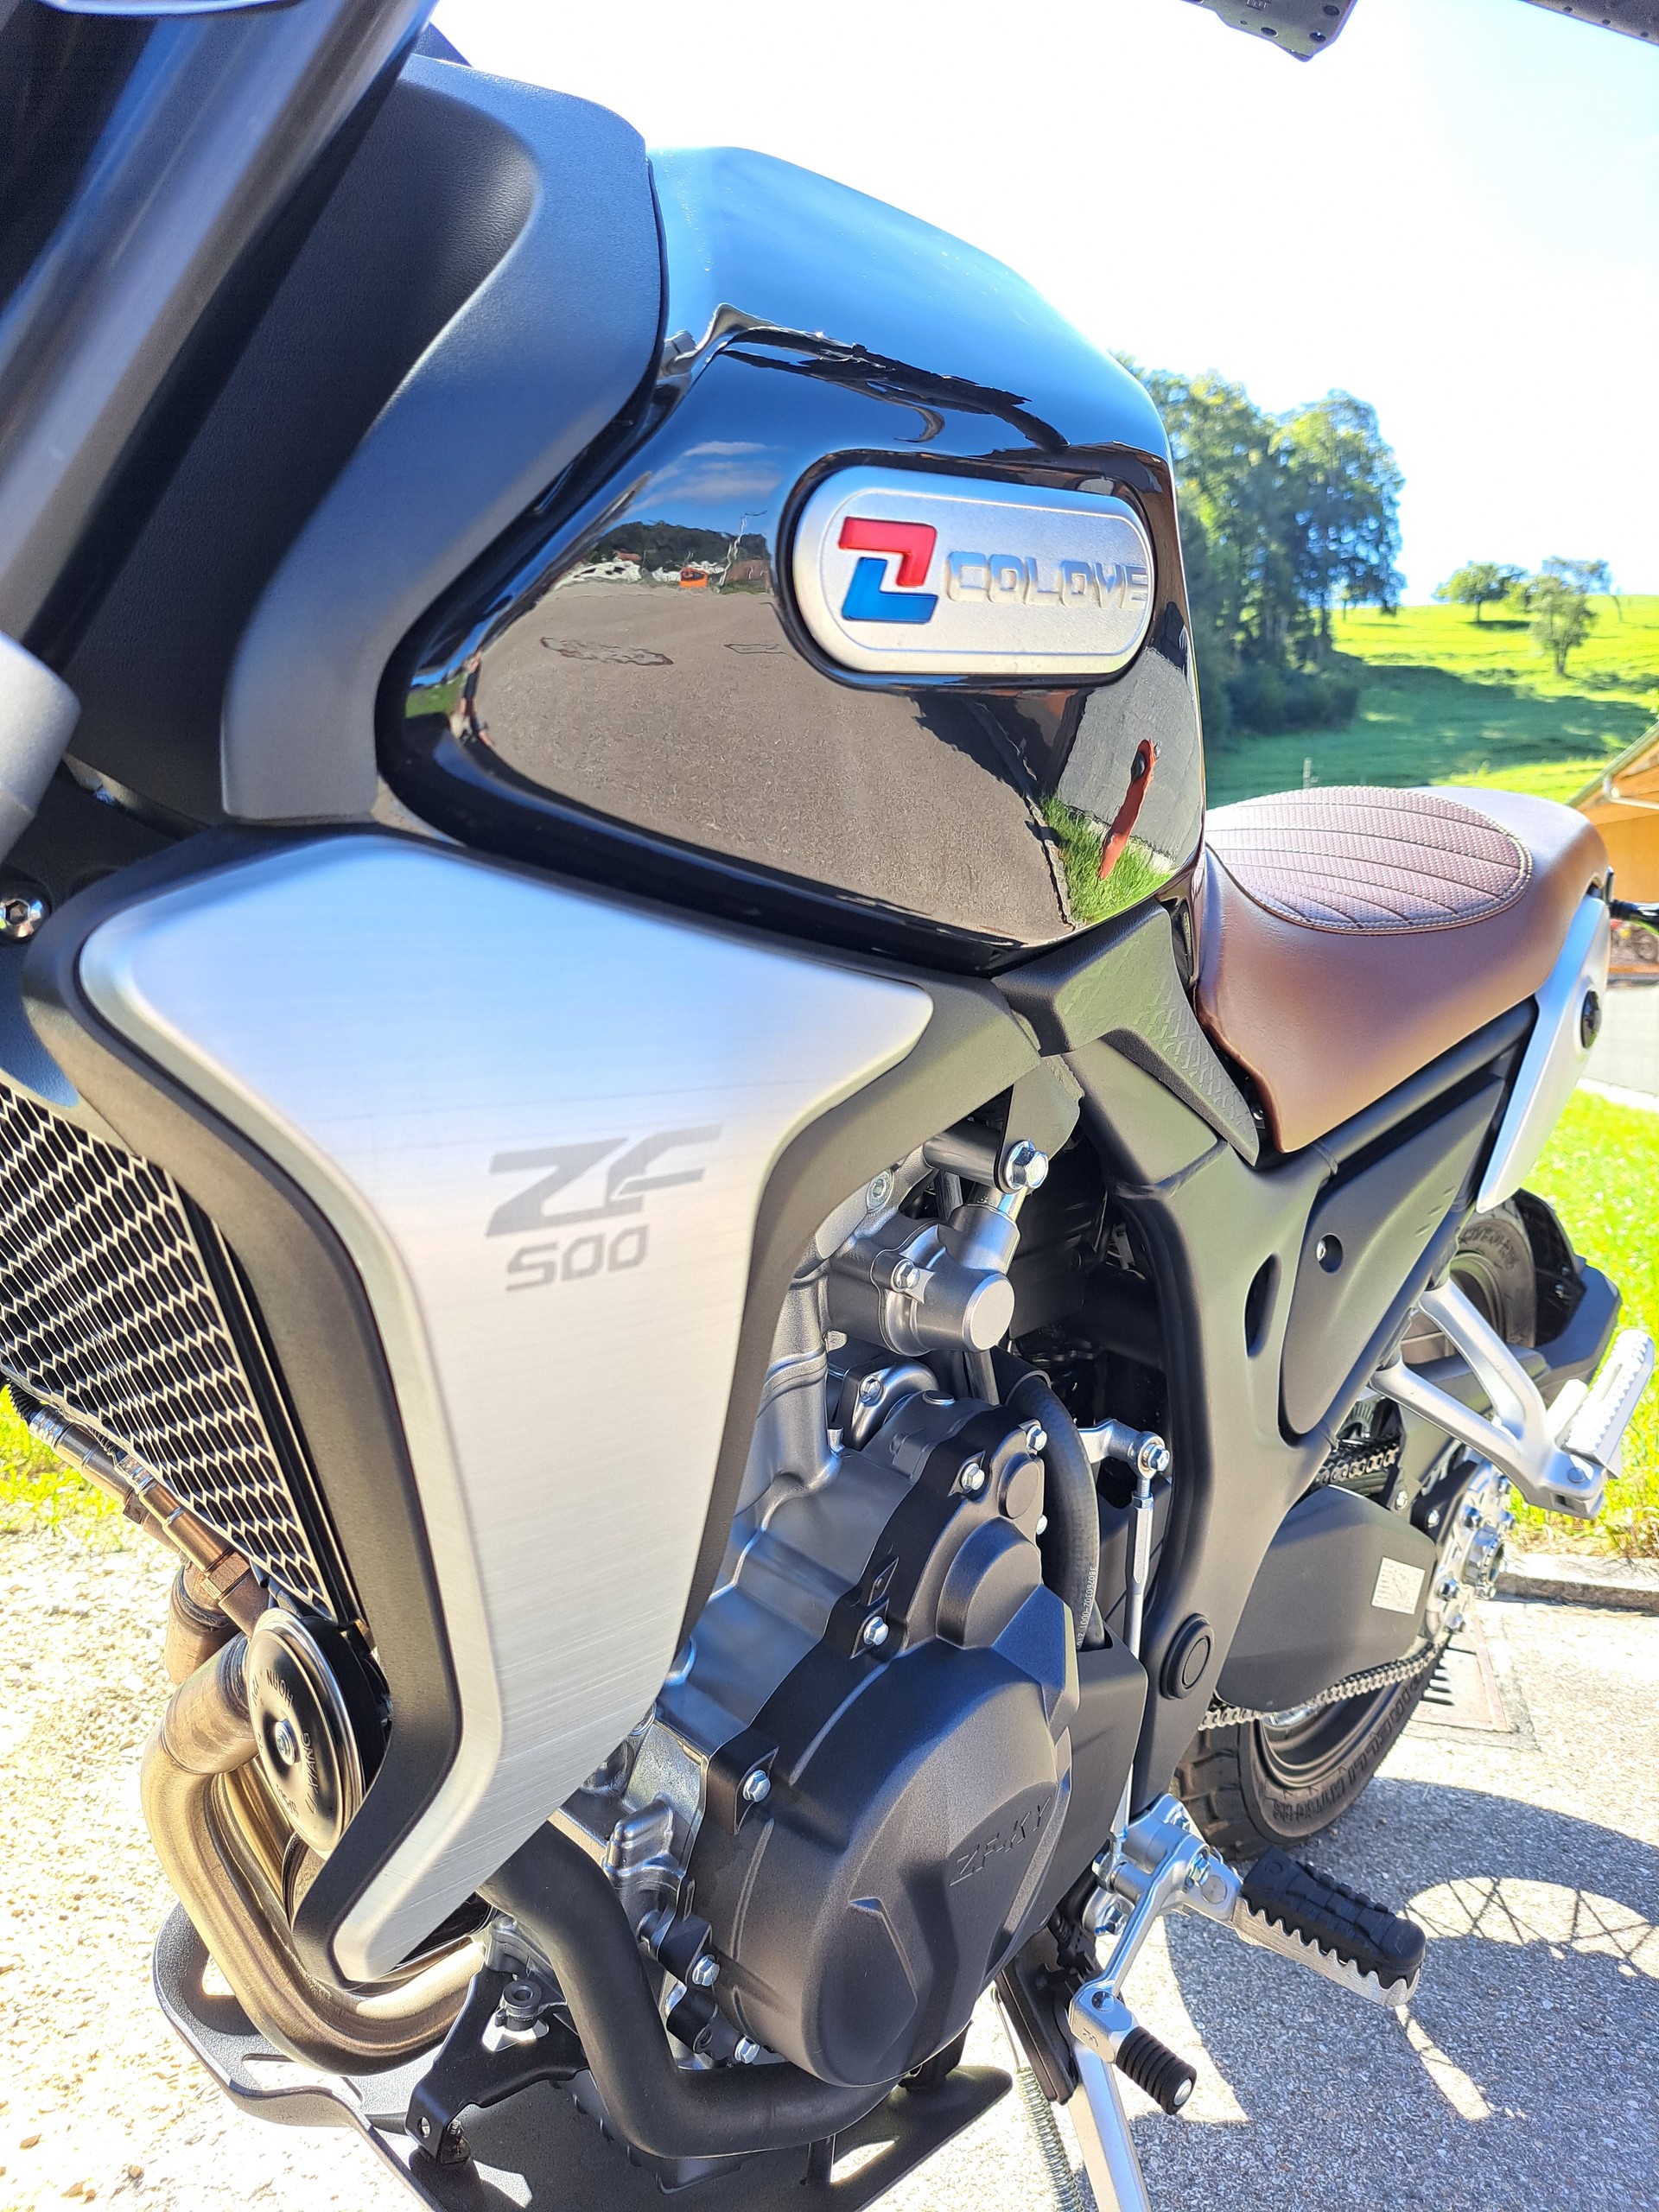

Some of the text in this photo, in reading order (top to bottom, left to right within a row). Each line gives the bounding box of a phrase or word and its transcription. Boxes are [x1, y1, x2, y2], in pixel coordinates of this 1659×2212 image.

[946, 550, 1148, 610] COLOVE
[485, 1123, 722, 1237] ZF
[506, 1224, 649, 1291] 500
[266, 1668, 294, 1708] HORN
